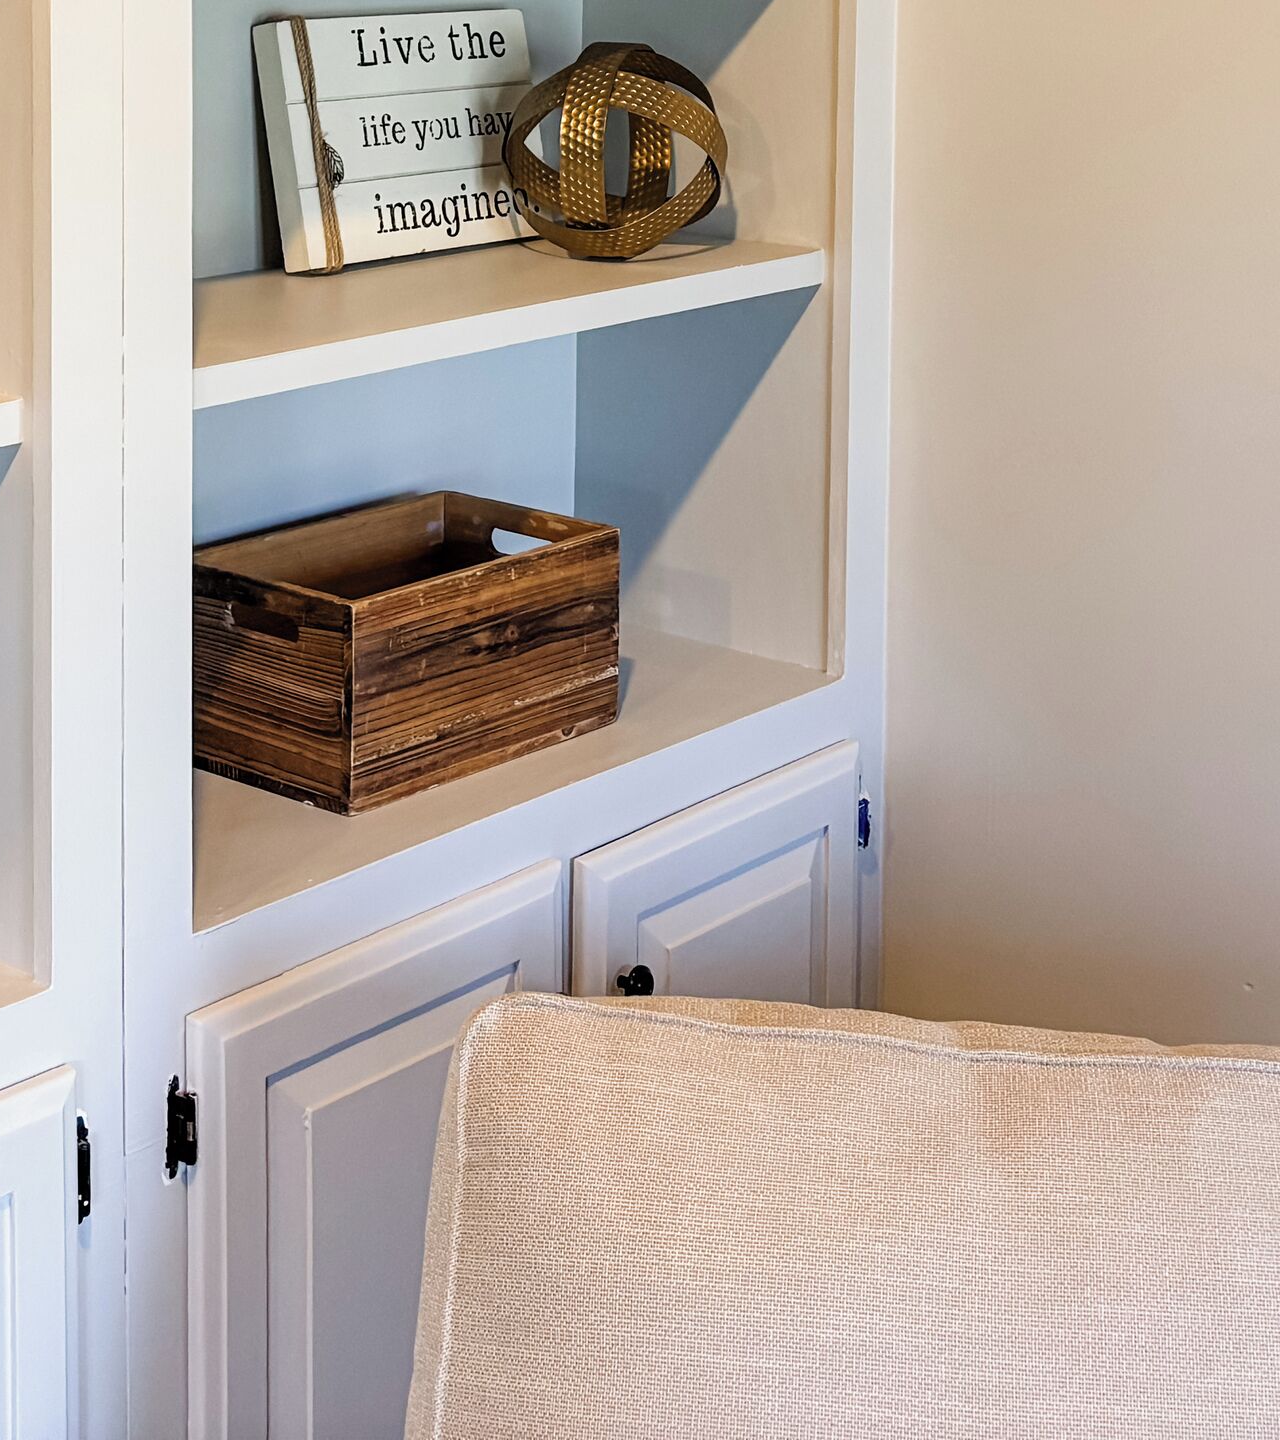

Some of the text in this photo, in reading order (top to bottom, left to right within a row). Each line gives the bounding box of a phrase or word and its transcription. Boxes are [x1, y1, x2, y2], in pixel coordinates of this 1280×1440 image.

[351, 23, 507, 67] Live the
[360, 109, 512, 151] life you hav
